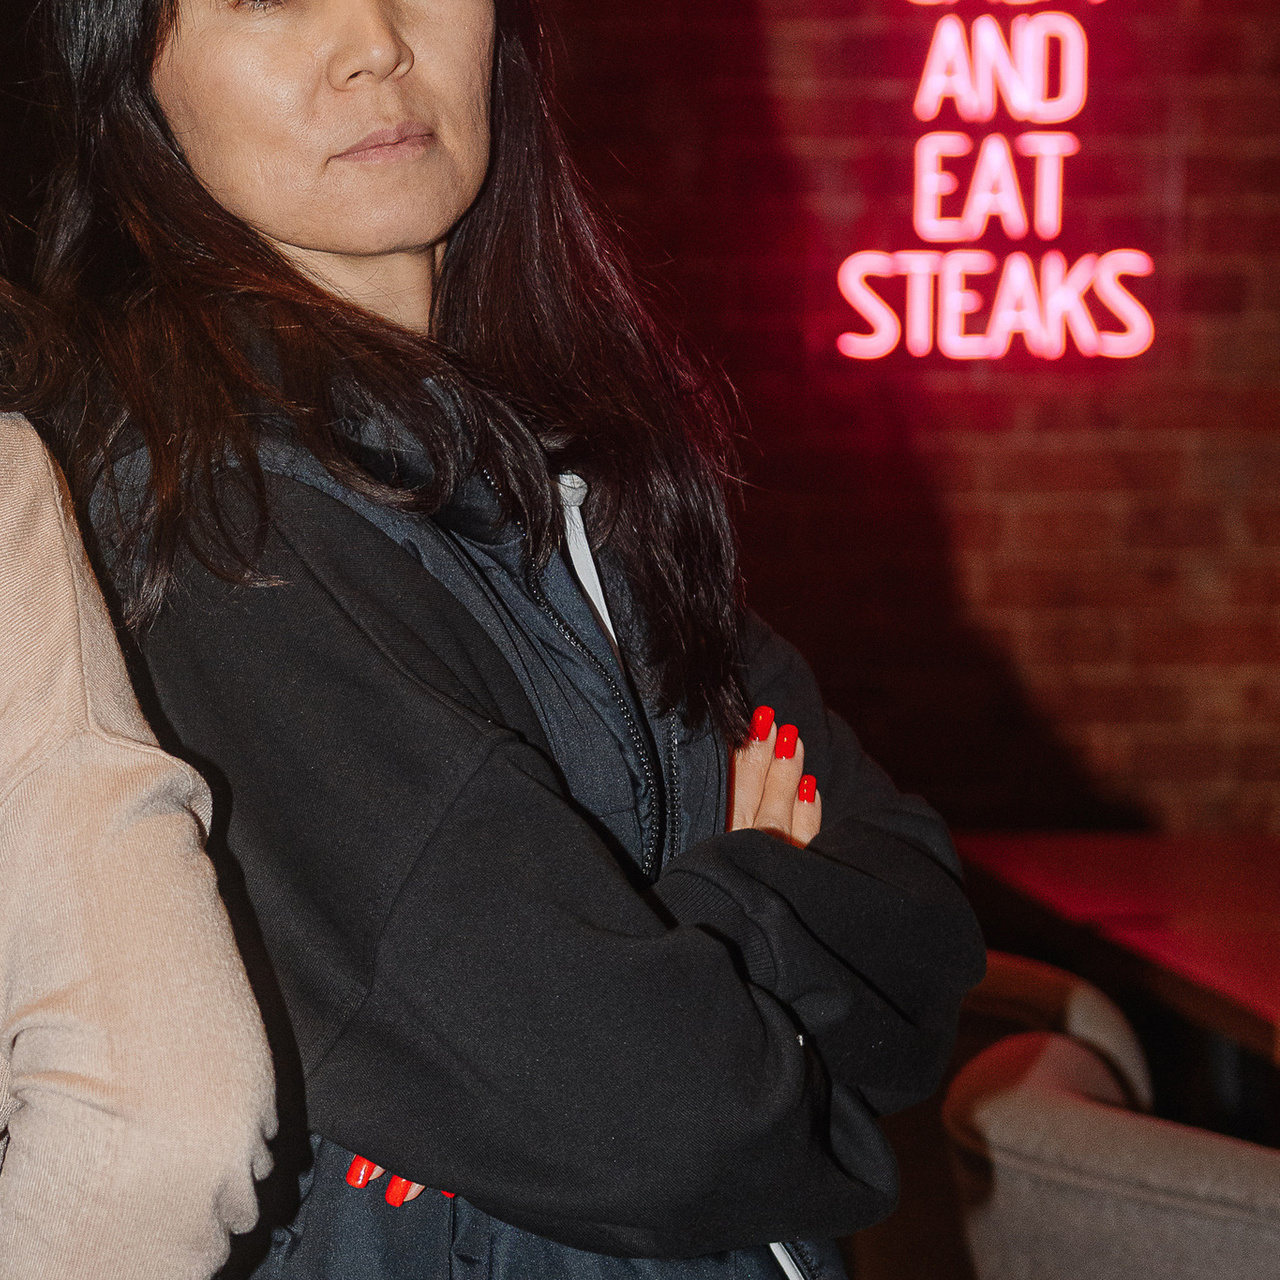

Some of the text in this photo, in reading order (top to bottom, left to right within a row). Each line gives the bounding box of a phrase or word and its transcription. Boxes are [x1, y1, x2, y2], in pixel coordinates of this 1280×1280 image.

[913, 10, 1088, 124] AND
[913, 131, 1079, 243] EAT
[837, 247, 1155, 360] STEAKS
